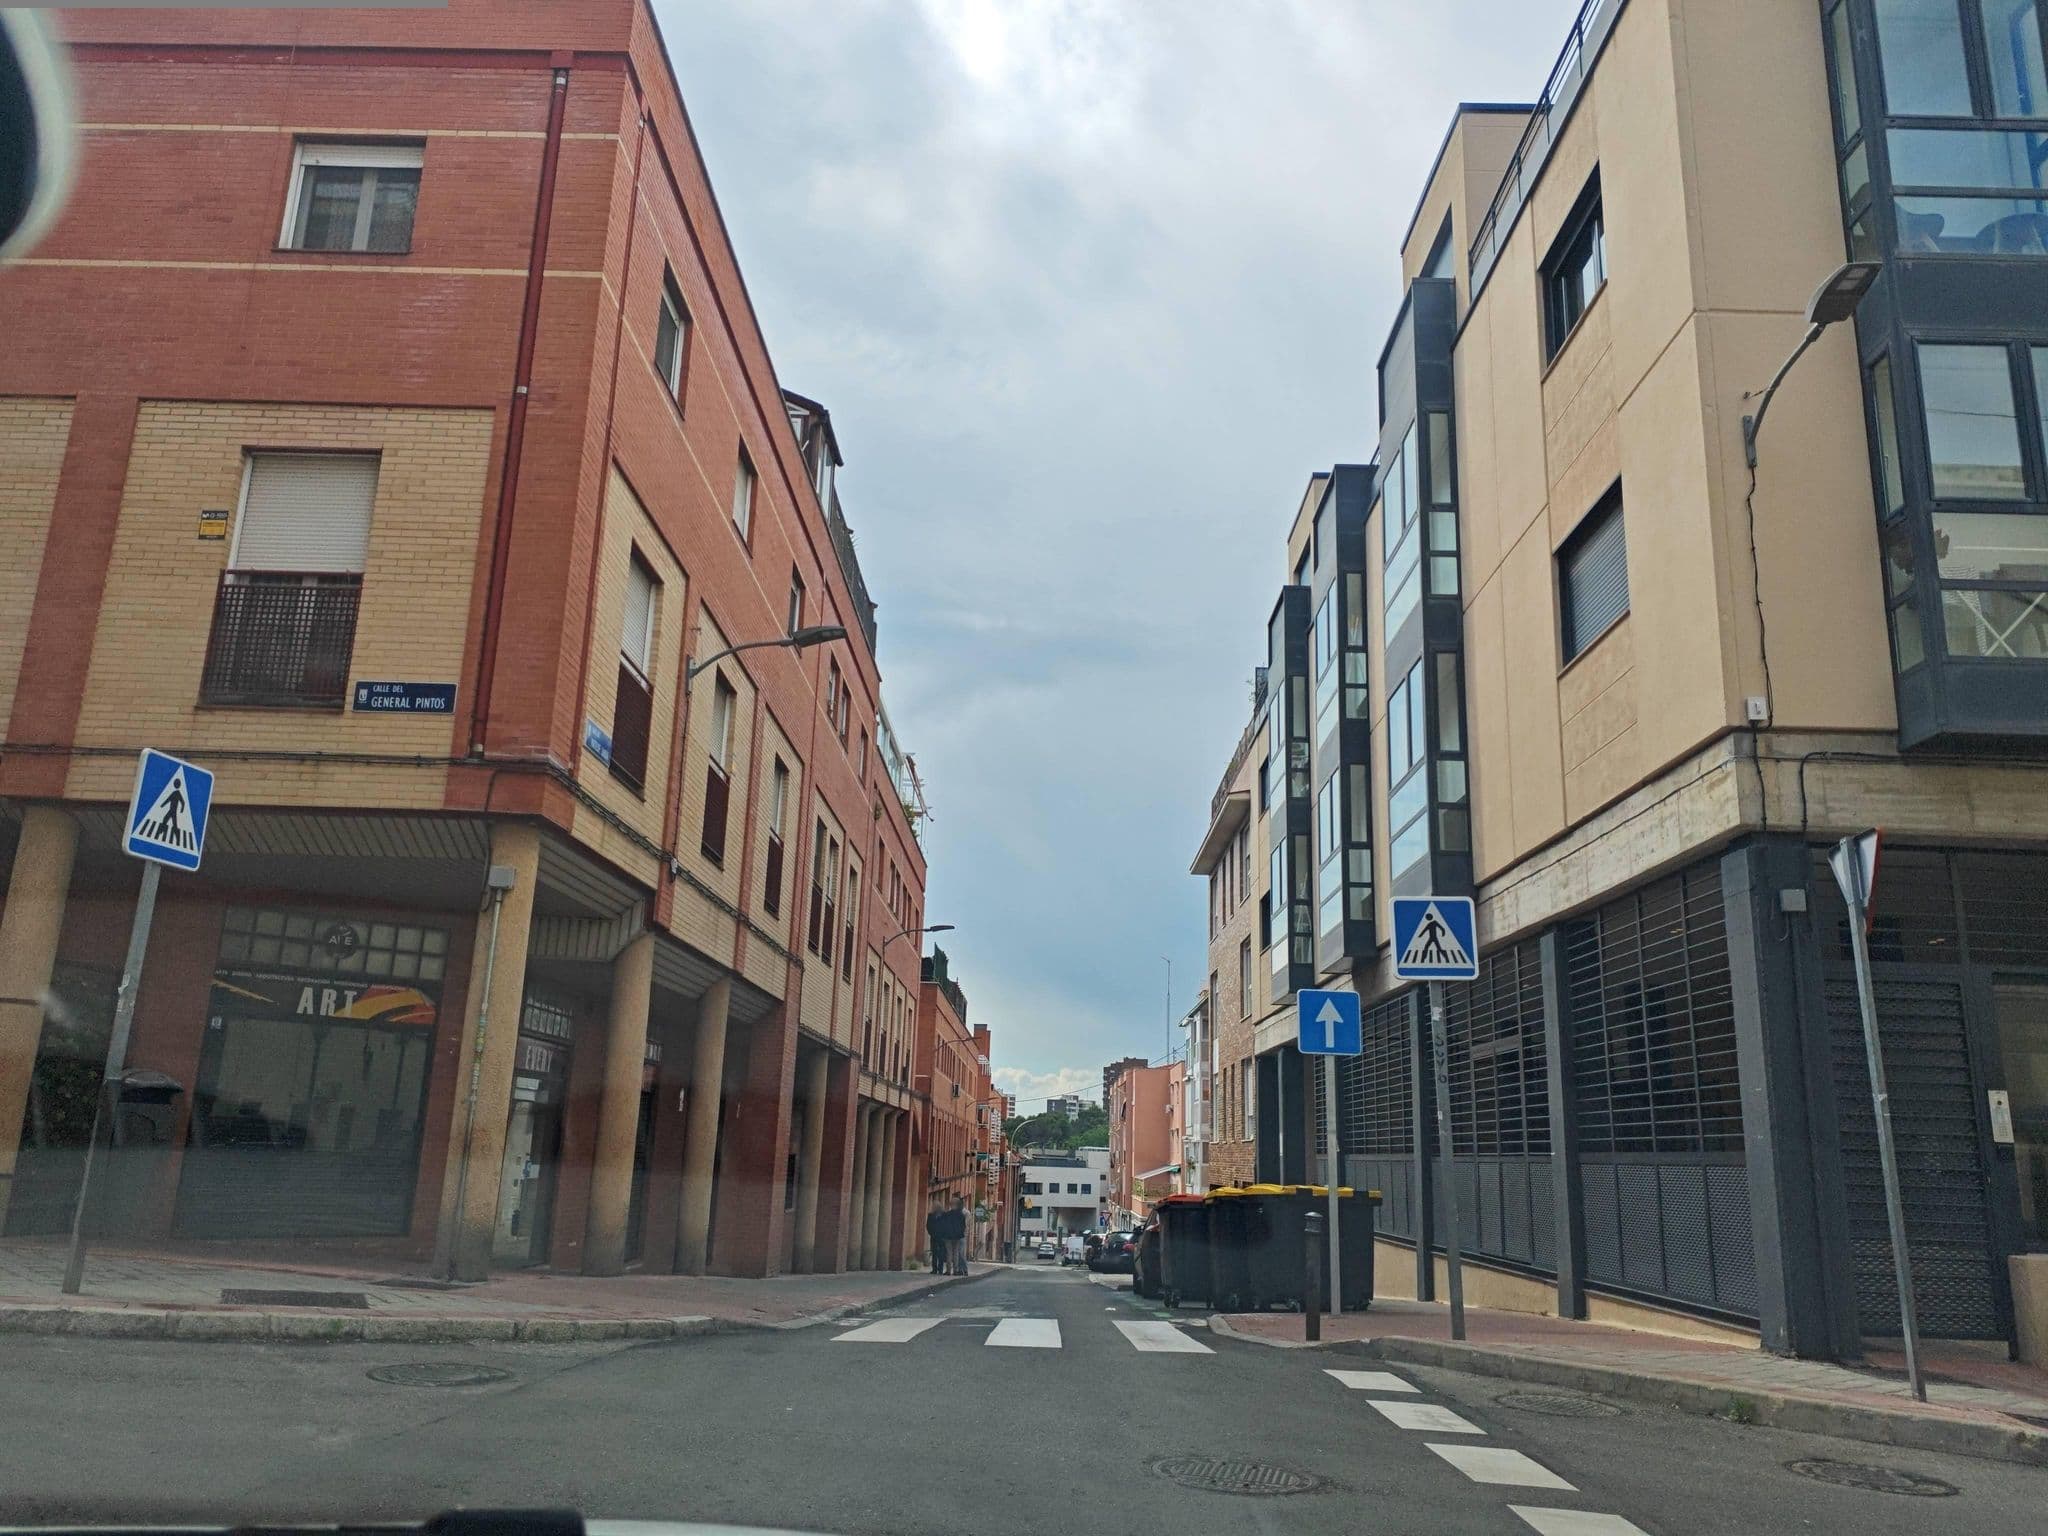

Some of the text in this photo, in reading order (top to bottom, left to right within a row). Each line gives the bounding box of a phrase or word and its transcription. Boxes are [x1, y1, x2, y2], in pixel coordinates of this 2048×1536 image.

[373, 685, 390, 693] CALLE
[371, 697, 446, 710] GENERAL PINTOS
[296, 986, 358, 1016] ART
[525, 1045, 554, 1073] EVERY
